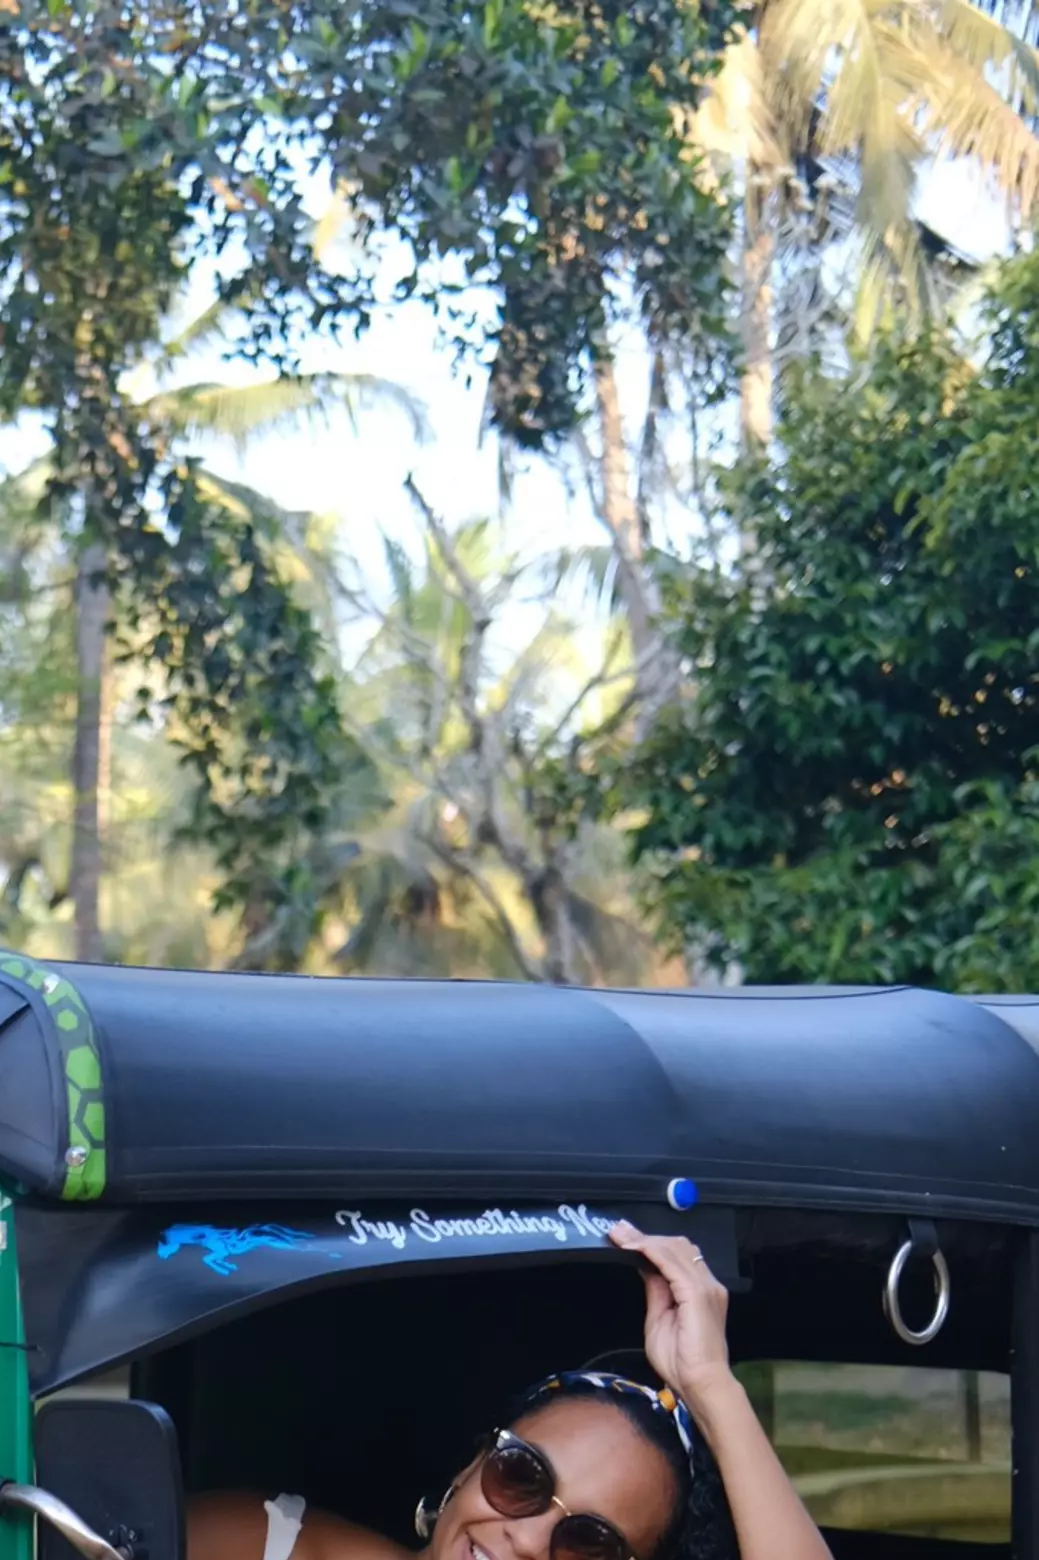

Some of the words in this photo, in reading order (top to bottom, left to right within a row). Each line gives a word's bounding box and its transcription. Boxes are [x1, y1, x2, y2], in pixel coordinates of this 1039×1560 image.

[335, 1210, 406, 1249] Try
[410, 1208, 567, 1242] Something
[558, 1204, 616, 1237] Ne
